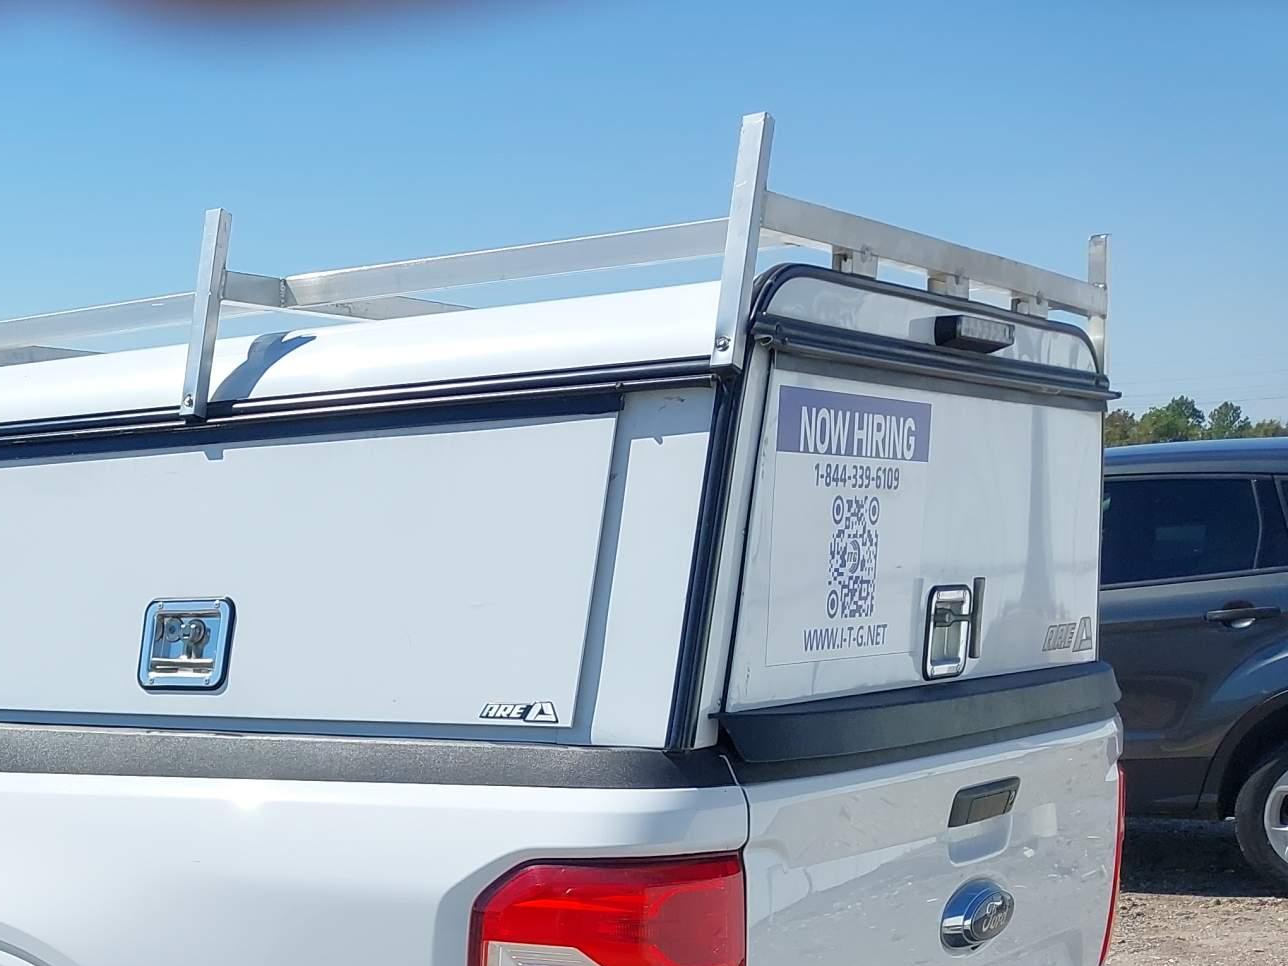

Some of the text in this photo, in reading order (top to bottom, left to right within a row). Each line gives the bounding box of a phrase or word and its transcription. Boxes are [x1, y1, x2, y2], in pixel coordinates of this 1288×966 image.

[799, 405, 916, 461] NOW HIRING
[814, 462, 900, 491] 1-844-339-6109
[803, 623, 888, 652] WWW.I-T-G.NET
